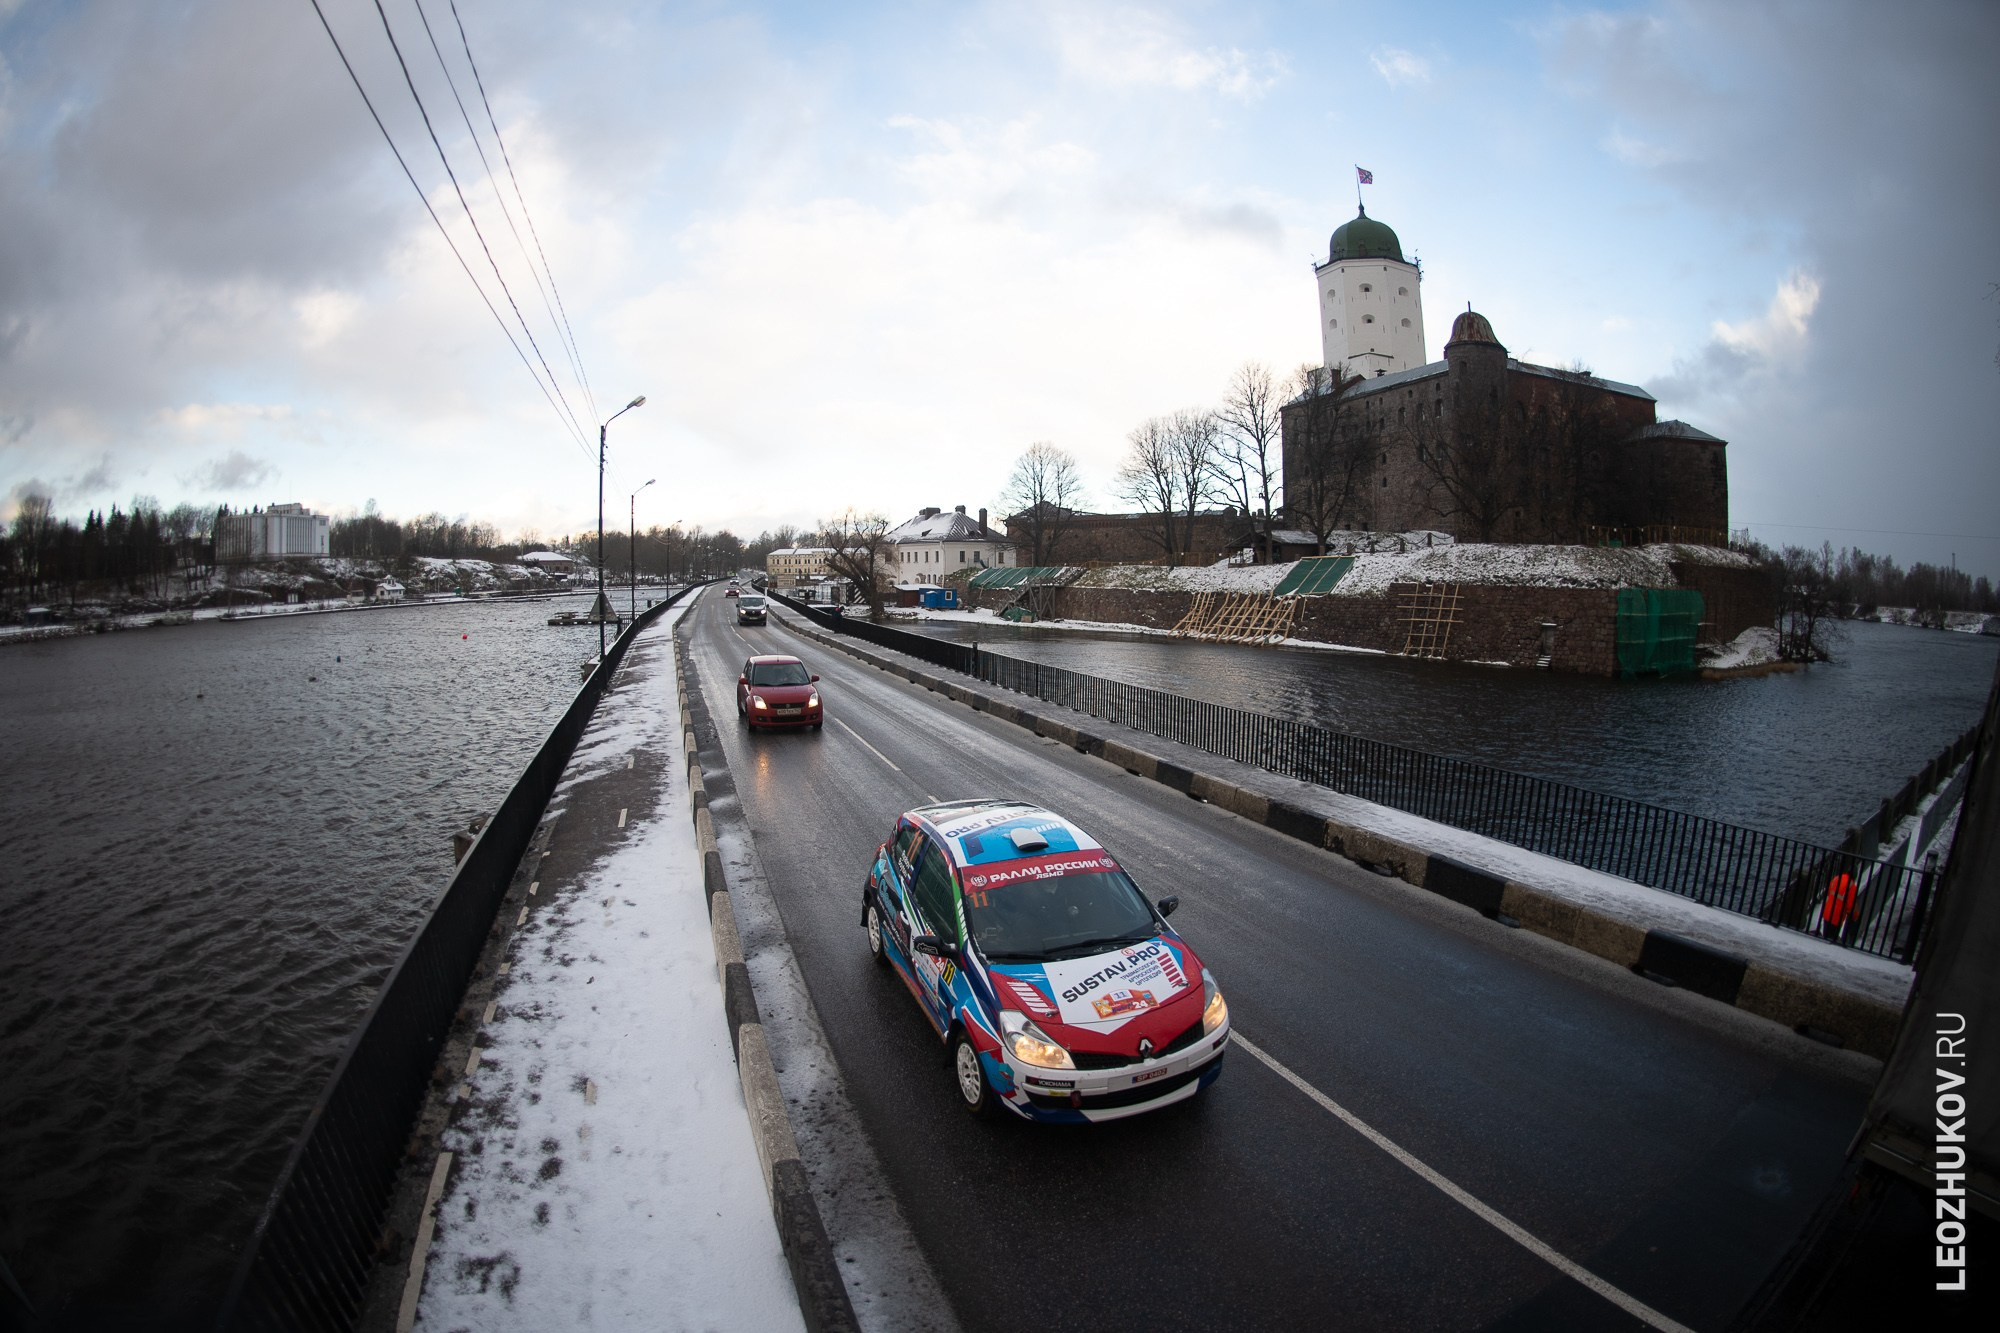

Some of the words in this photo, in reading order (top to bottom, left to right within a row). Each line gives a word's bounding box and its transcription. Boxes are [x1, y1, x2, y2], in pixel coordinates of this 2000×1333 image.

[908, 830, 924, 862] 11
[989, 865, 1042, 883] РАЛЛИ
[1043, 860, 1100, 874] РОССИИ
[970, 891, 989, 908] 11
[943, 962, 955, 985] 11
[1062, 945, 1161, 1003] SUSTAV.PRO
[1114, 991, 1127, 999] 11
[1132, 1000, 1149, 1009] 24
[1137, 1073, 1150, 1082] SP
